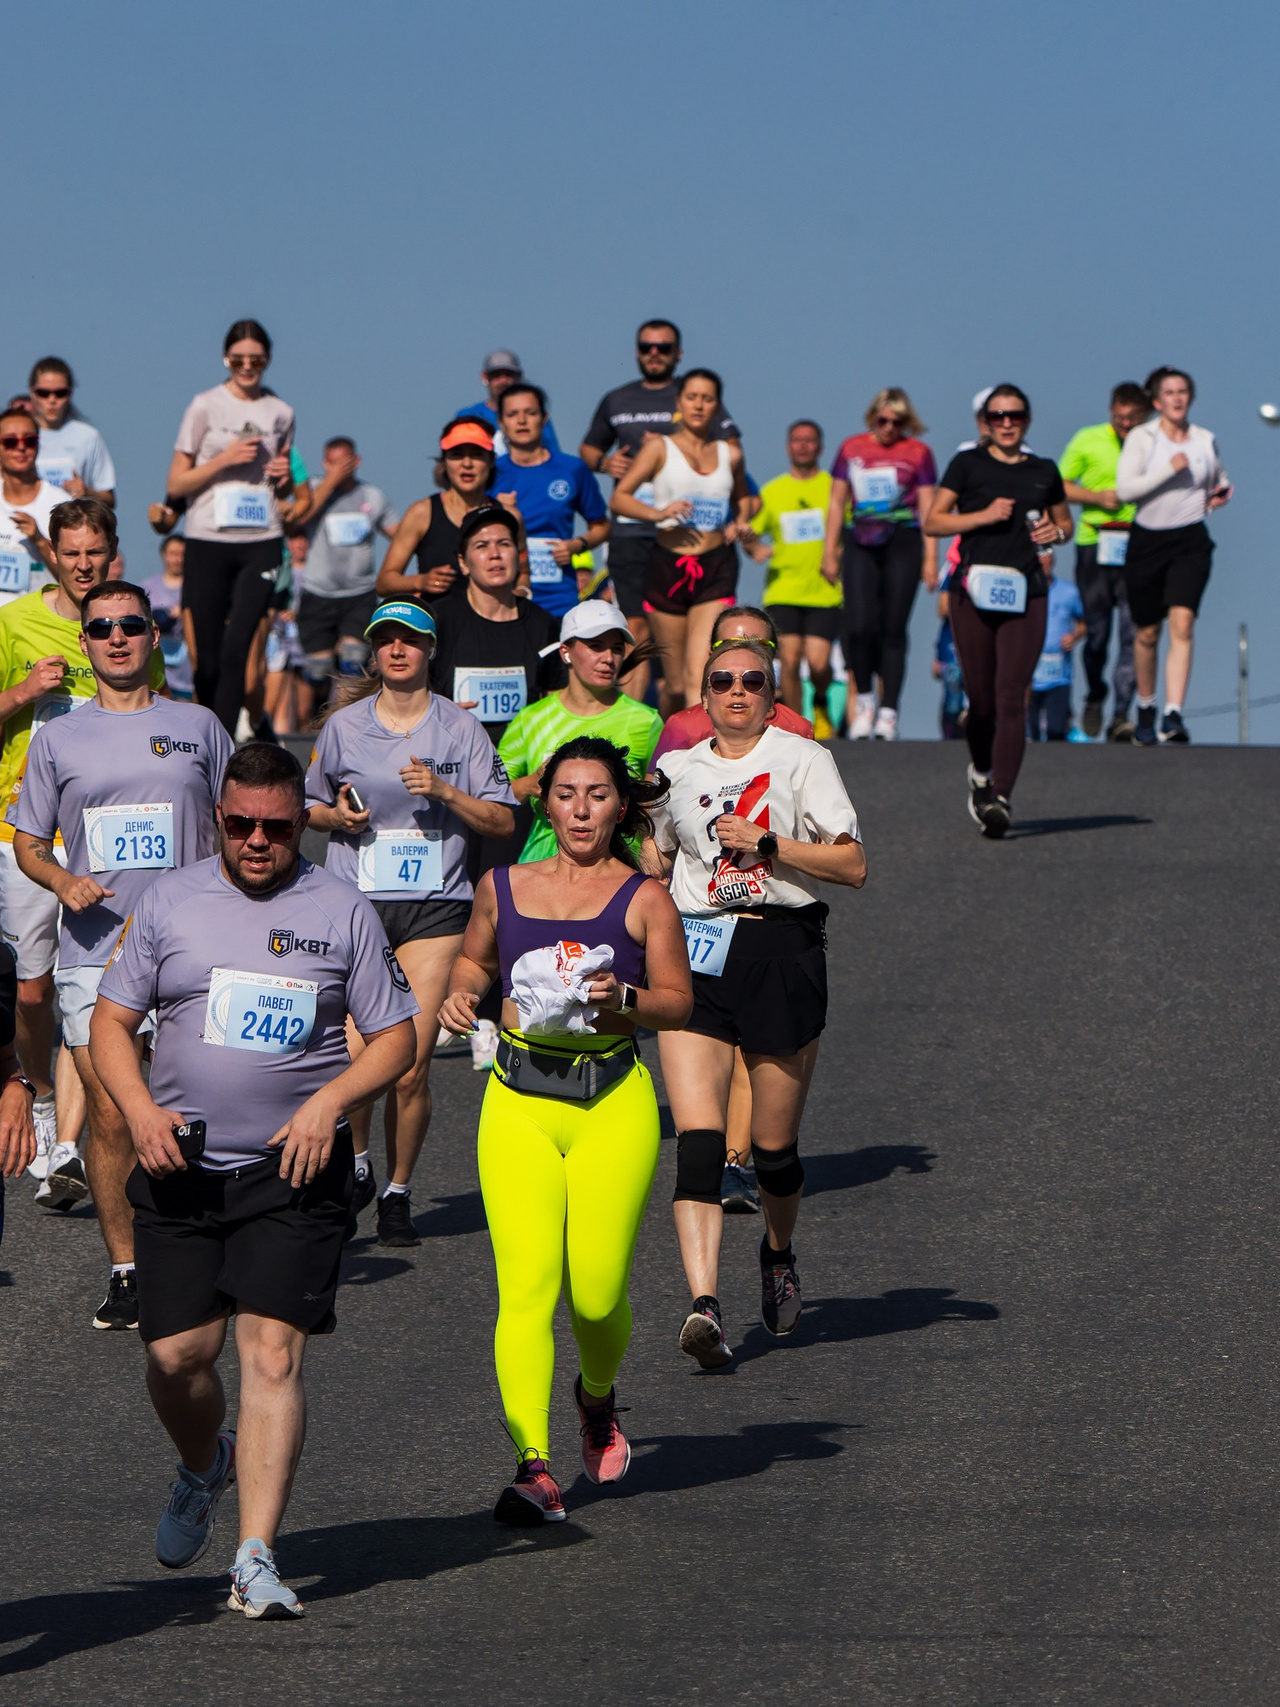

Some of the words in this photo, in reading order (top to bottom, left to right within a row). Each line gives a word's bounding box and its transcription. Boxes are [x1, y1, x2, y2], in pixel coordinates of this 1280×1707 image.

[480, 681, 519, 691] ЕКАТЕРИНА
[482, 693, 521, 714] 1192
[125, 821, 154, 833] ДЕНИС
[115, 835, 166, 861] 2133
[392, 846, 429, 856] ВАЛЕРИЯ
[398, 860, 422, 882] 47
[258, 995, 293, 1011] ПАВЕЛ
[241, 1011, 305, 1046] 2442
